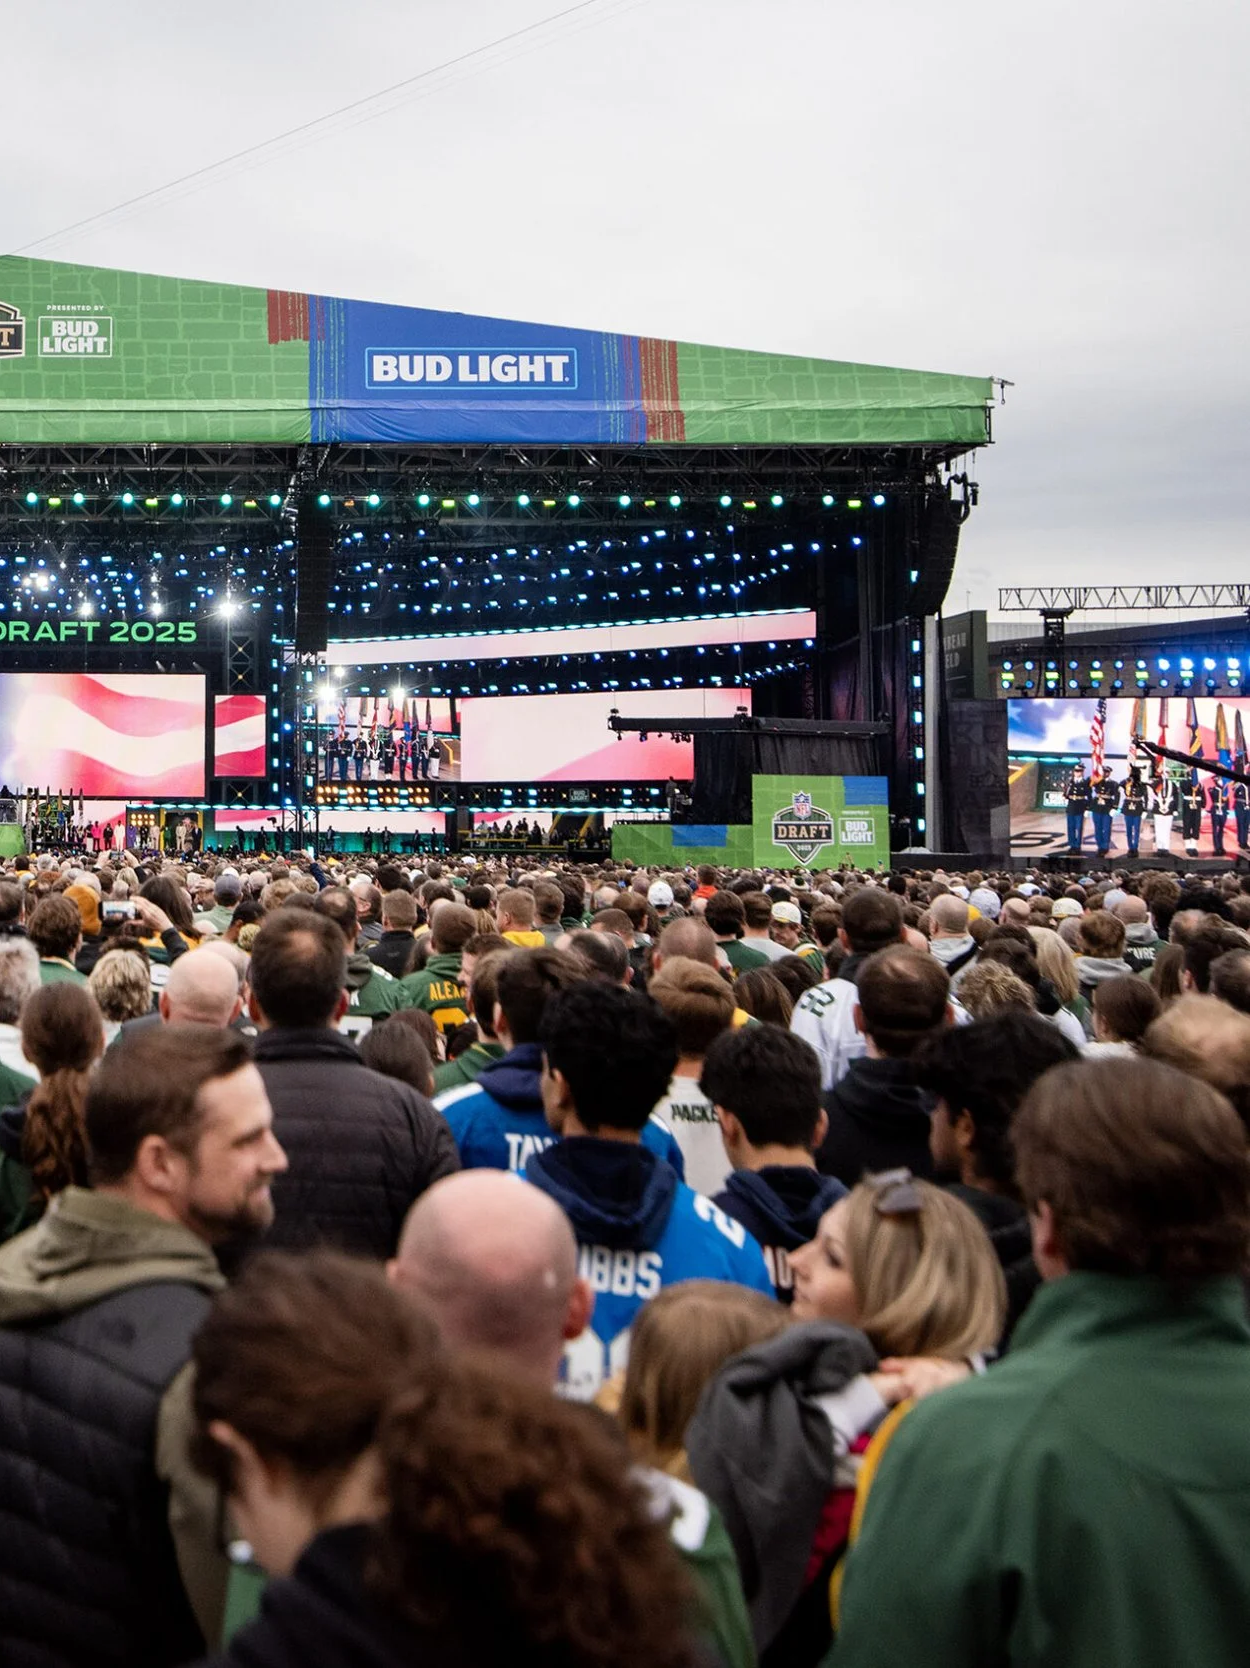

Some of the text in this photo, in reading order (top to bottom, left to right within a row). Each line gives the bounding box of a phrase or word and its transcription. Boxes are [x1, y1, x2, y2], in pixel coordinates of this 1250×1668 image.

[52, 320, 99, 337] BUD
[42, 336, 108, 353] LIGHT
[373, 354, 569, 382] BUD LIGHT
[110, 621, 197, 643] 2025
[777, 825, 829, 838] DRAFT
[845, 821, 868, 831] BUD
[842, 831, 872, 842] LIGHT
